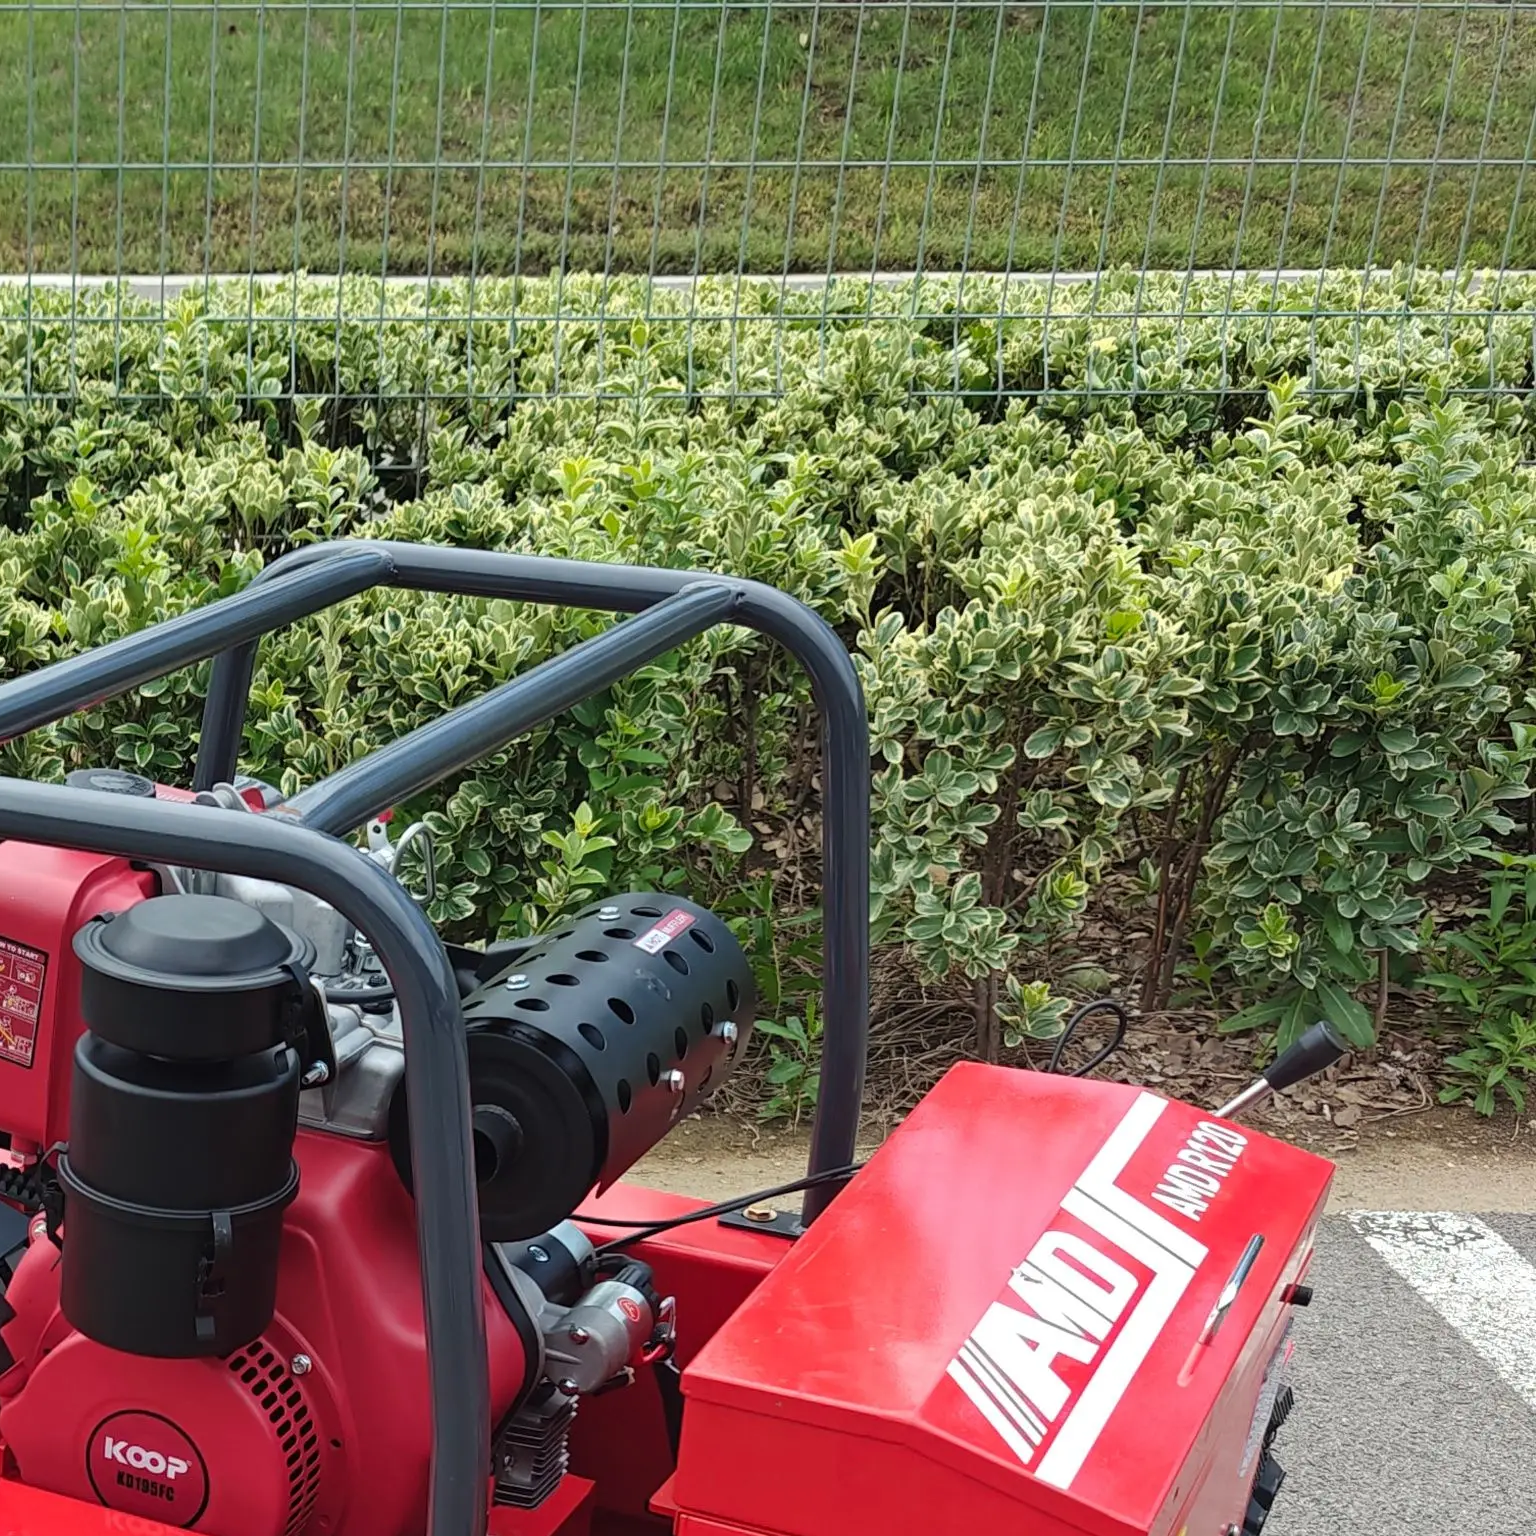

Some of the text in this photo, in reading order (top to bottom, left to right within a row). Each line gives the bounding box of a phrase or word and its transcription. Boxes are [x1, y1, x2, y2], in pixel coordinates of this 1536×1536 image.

[7, 943, 16, 953] TO
[17, 947, 39, 960] START
[104, 1436, 189, 1480] KOOP
[117, 1471, 175, 1501] KD195FC
